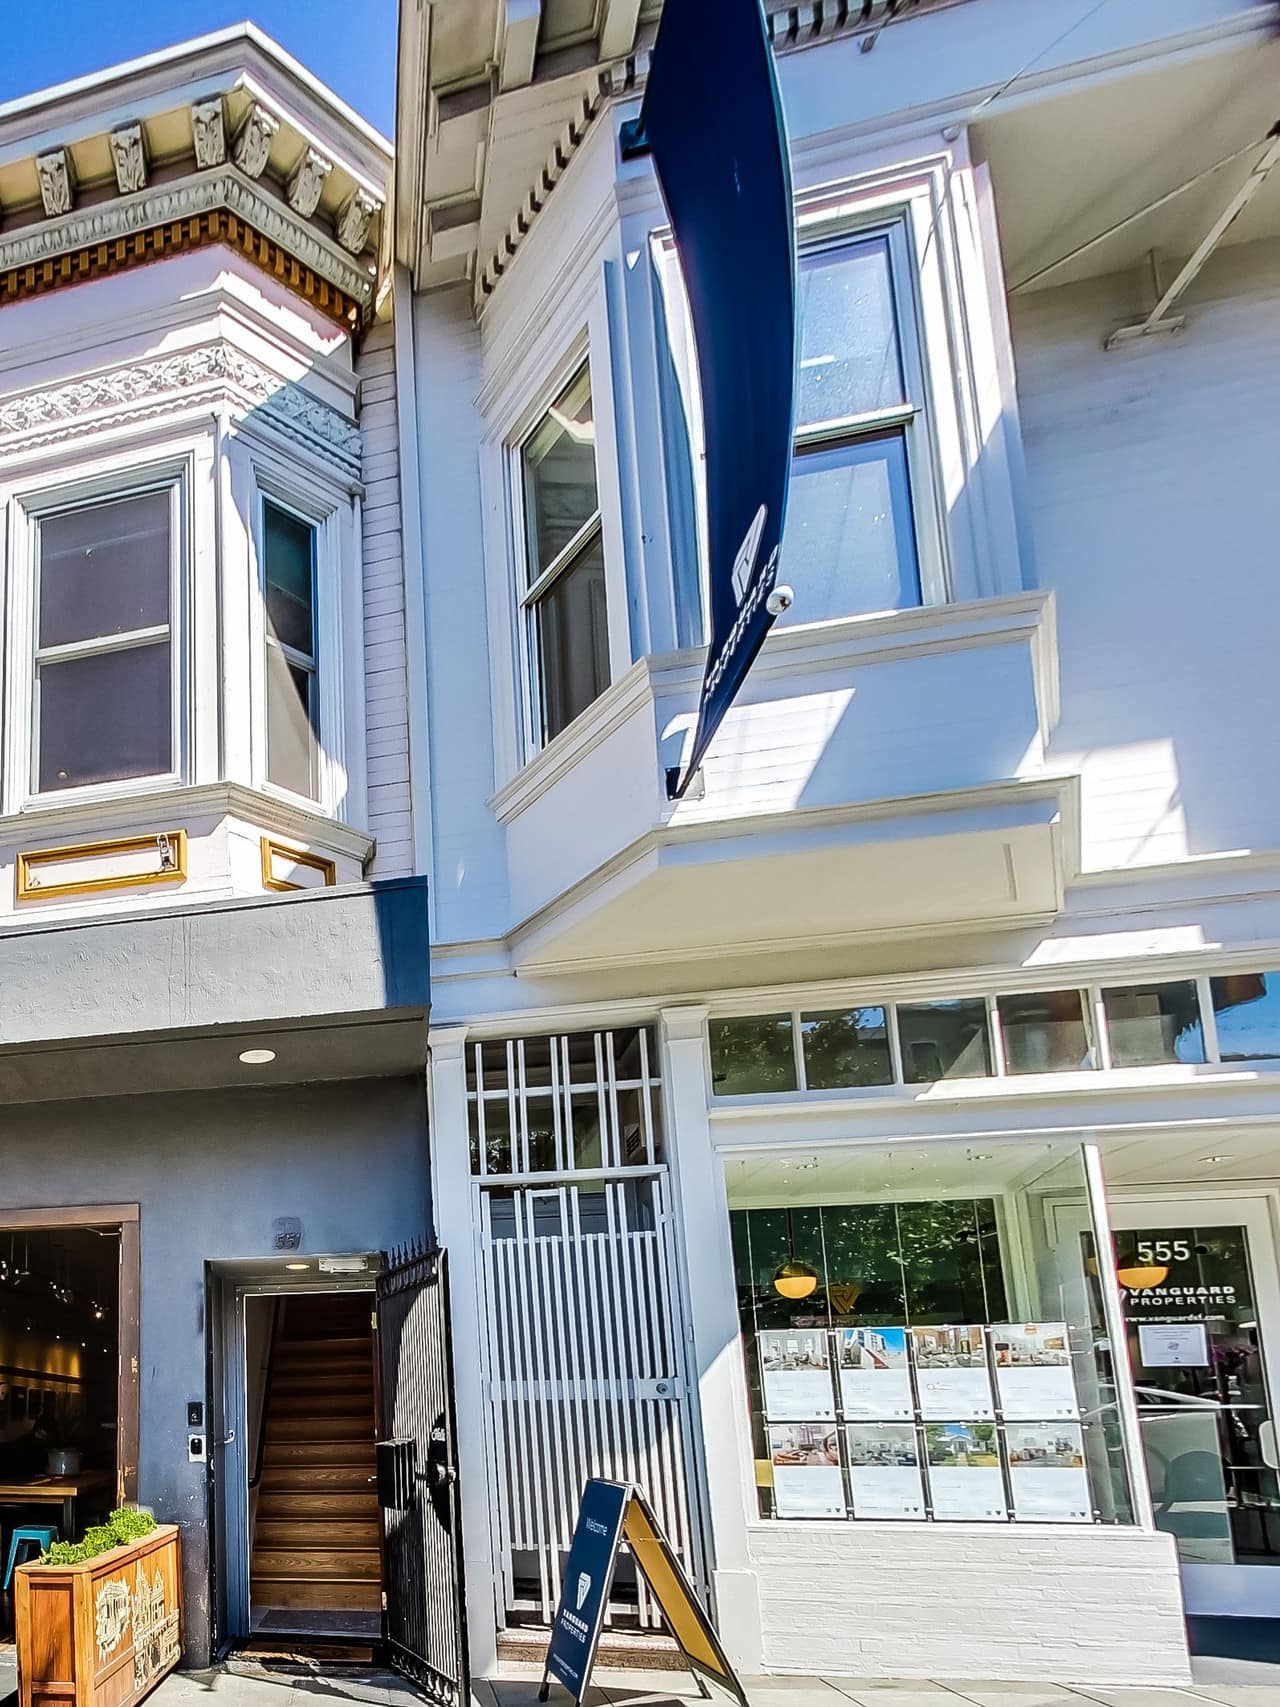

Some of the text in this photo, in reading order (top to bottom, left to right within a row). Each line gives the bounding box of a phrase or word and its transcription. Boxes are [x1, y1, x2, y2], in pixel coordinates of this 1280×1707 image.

[1137, 1240, 1191, 1262] 555
[1130, 1286, 1236, 1296] VANGUARD
[1129, 1295, 1237, 1306] PROPERTIES
